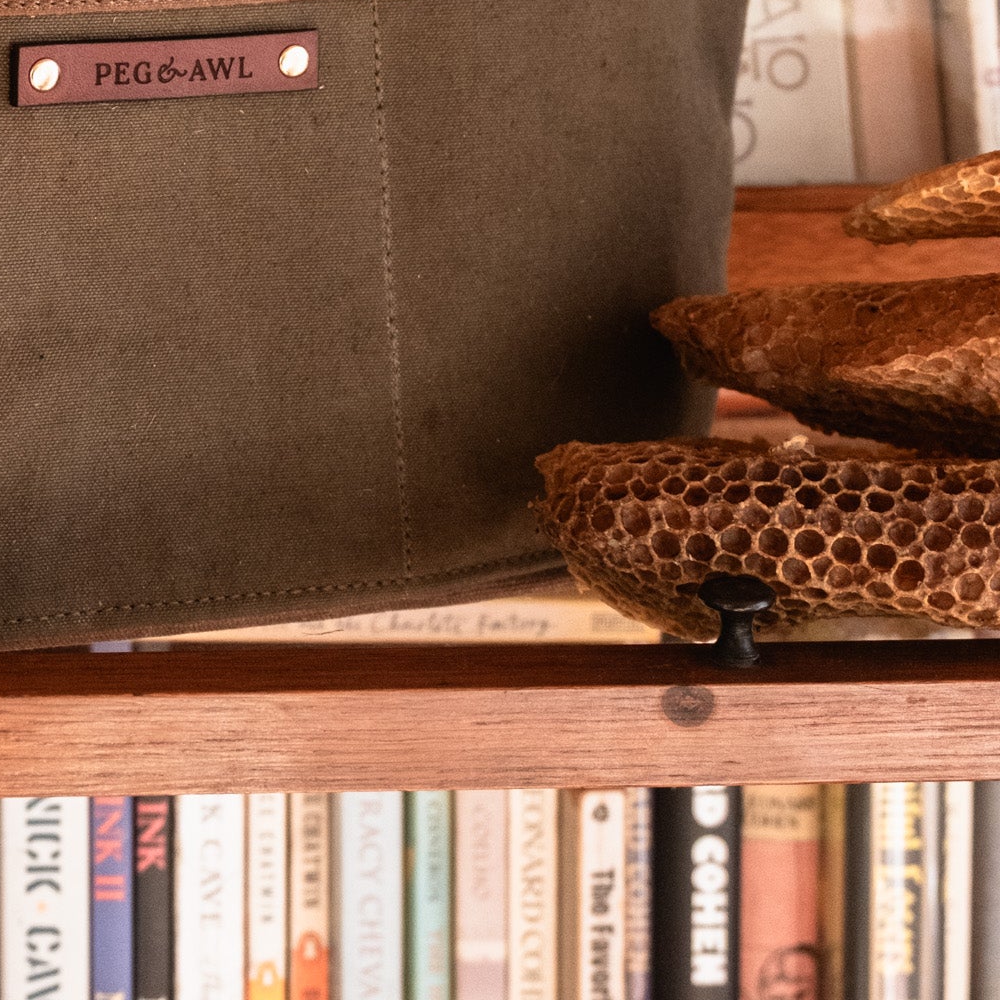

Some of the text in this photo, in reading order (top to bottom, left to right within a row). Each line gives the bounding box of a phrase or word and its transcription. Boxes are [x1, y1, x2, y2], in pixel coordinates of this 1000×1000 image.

[136, 801, 169, 874] INK
[690, 787, 729, 986] D COHEN
